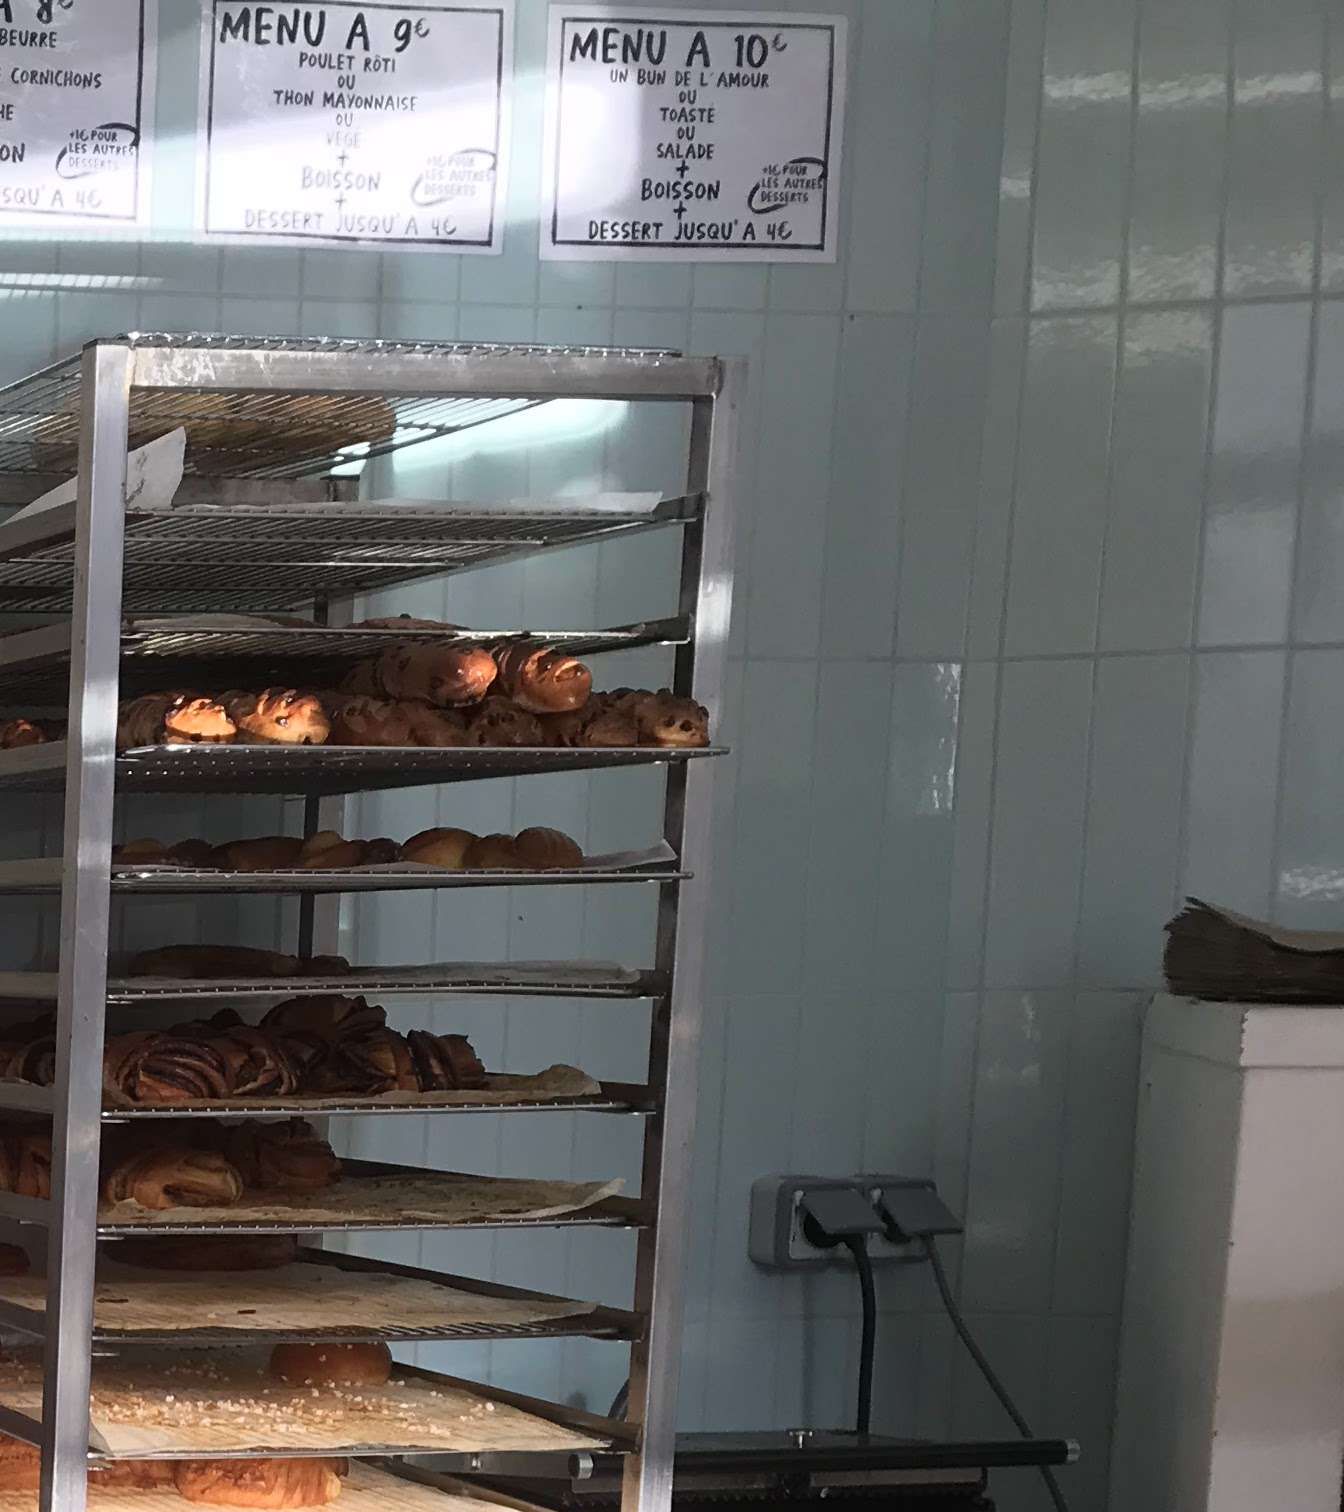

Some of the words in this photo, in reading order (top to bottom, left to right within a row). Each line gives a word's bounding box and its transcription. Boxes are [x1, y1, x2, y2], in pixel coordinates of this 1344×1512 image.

[0, 29, 57, 48] BEURRE
[220, 7, 326, 47] MENU
[345, 12, 370, 52] A
[569, 27, 667, 65] MENU
[685, 31, 710, 67] A
[299, 51, 355, 71] POULET
[12, 67, 102, 89] CORNICHONS
[337, 74, 355, 90] OU
[610, 69, 629, 84] UN
[637, 69, 666, 86] BUN
[675, 71, 692, 87] DE
[273, 89, 314, 106] THON
[323, 92, 418, 111] MAYONNAISE
[679, 90, 697, 105] OU
[336, 112, 353, 127] OU
[660, 106, 715, 124] TOASTE
[90, 129, 118, 142] POUR
[677, 125, 696, 141] OU
[68, 142, 87, 155] LES
[93, 143, 134, 157] AUTRES
[656, 142, 715, 160] SALADE
[301, 166, 381, 192] BOISSON
[782, 164, 808, 177] POUR
[641, 177, 720, 202] BOISSON
[761, 176, 779, 189] LES
[784, 177, 824, 190] AUTRES
[760, 190, 809, 203] DESSERTS
[244, 208, 324, 230] DESSERT
[588, 220, 664, 241] DESSERT
[766, 220, 793, 241] 4€
